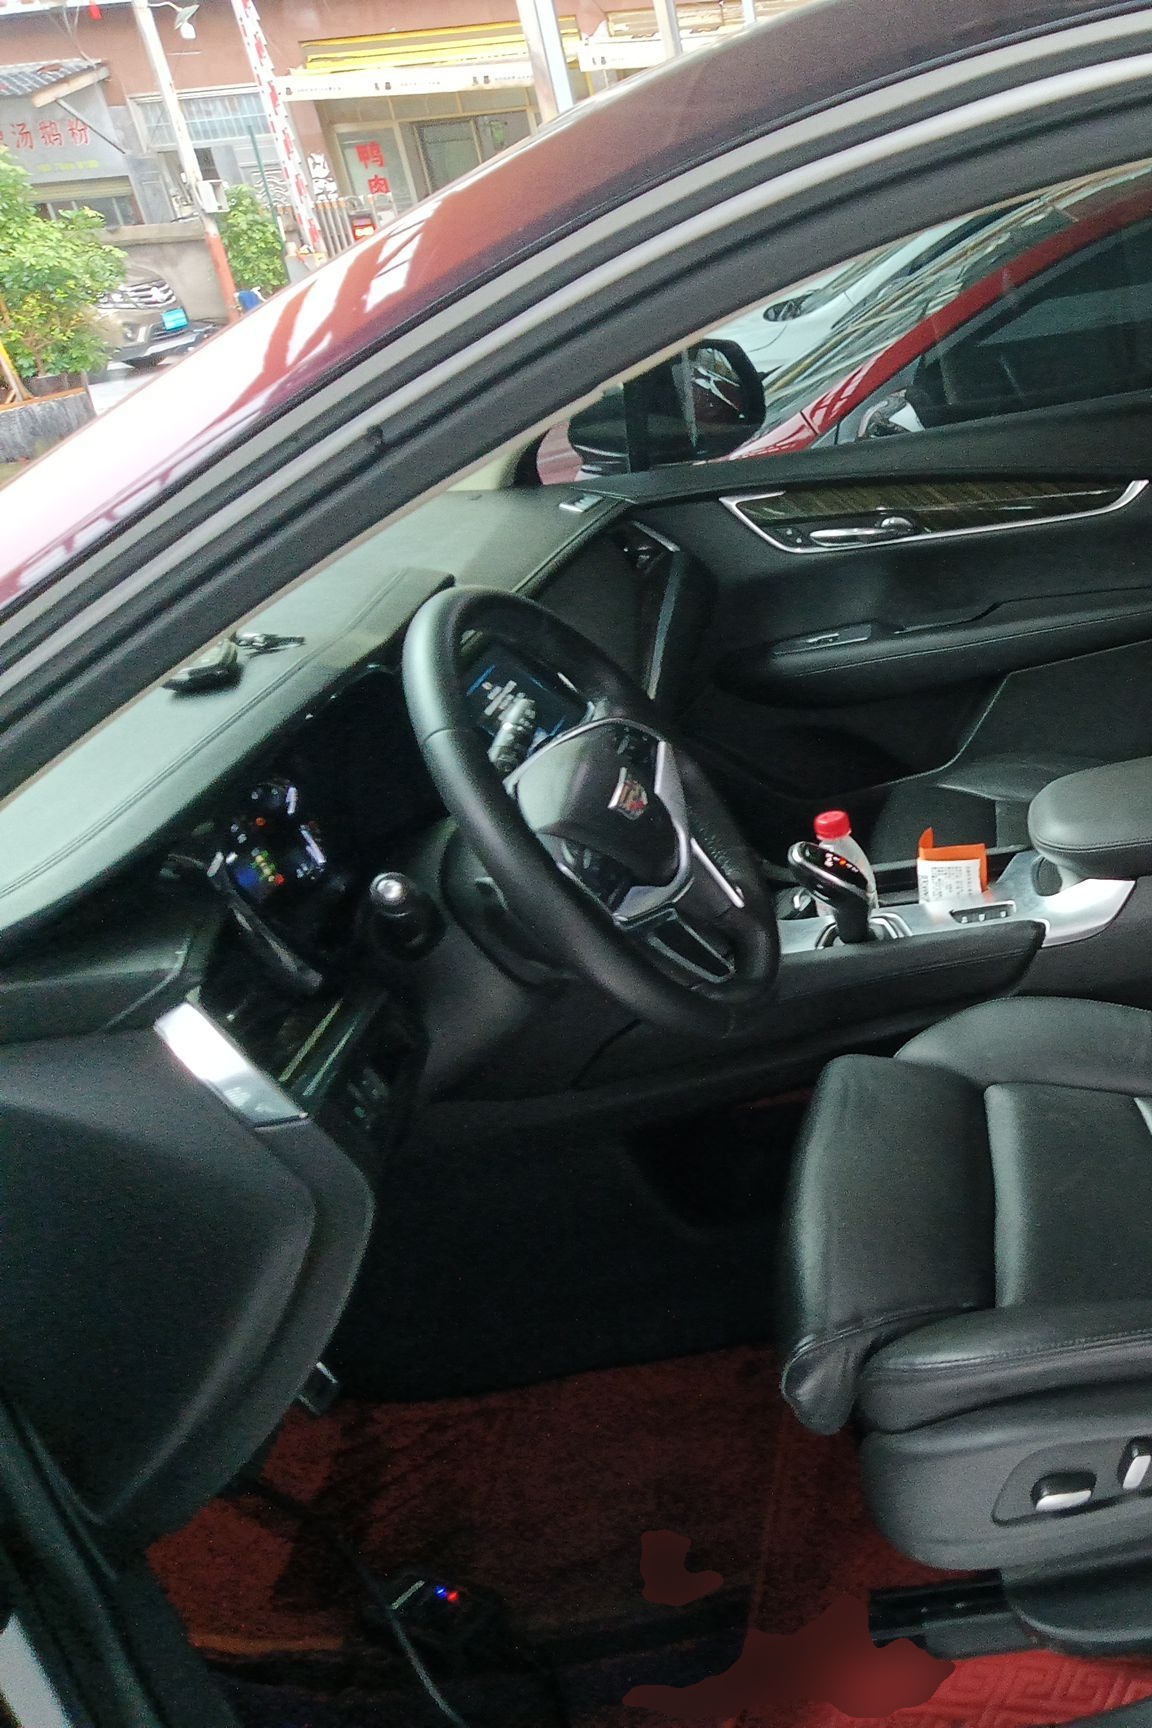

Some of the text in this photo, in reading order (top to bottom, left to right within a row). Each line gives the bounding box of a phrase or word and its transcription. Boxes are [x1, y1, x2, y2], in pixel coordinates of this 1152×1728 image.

[0, 118, 90, 150] 汤鹅粉
[355, 139, 392, 195] 鸭肉
